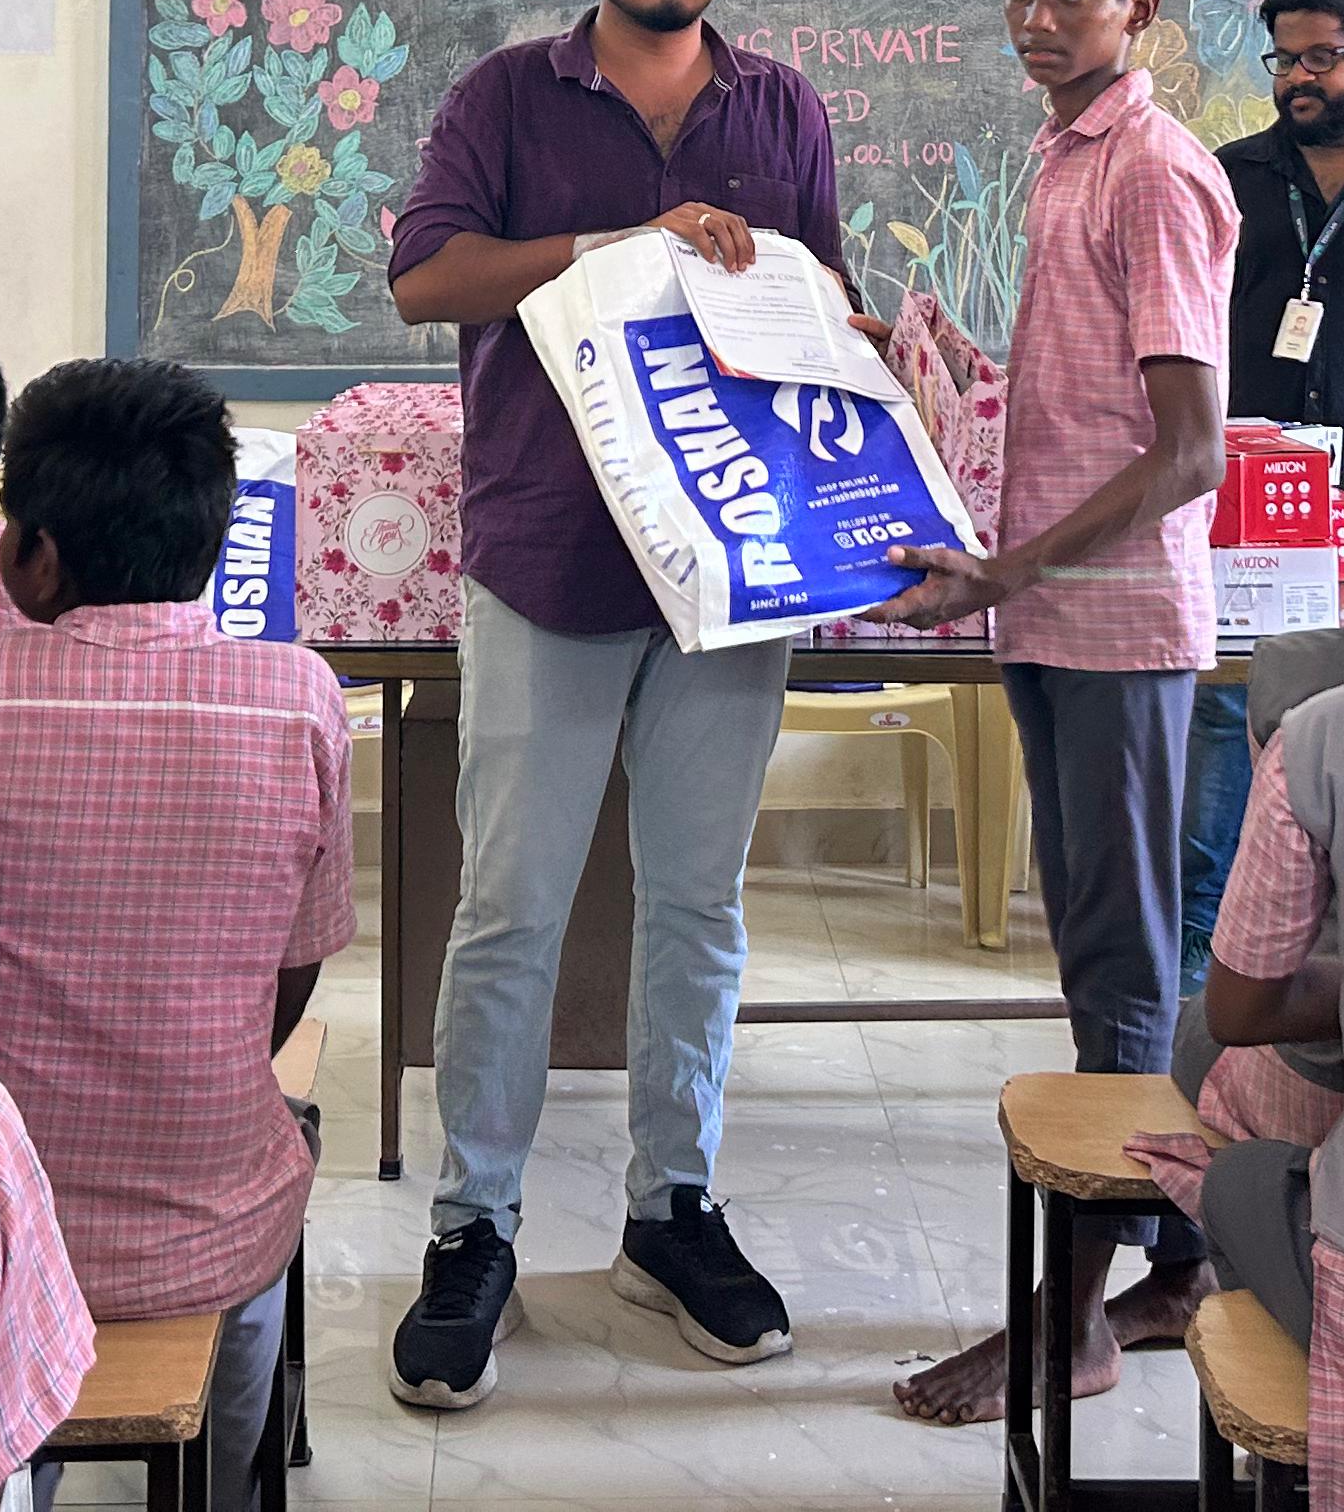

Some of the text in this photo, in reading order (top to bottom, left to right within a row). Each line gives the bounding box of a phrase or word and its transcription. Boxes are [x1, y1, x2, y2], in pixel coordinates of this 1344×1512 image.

[791, 24, 961, 73] PRIVATE
[641, 342, 805, 588] ROSHAN
[1263, 460, 1307, 475] MILTON
[815, 482, 838, 495] SHOP
[836, 516, 868, 530] FOLLOW
[1231, 556, 1280, 570] MILTON
[750, 591, 809, 611] SINCE 1963
